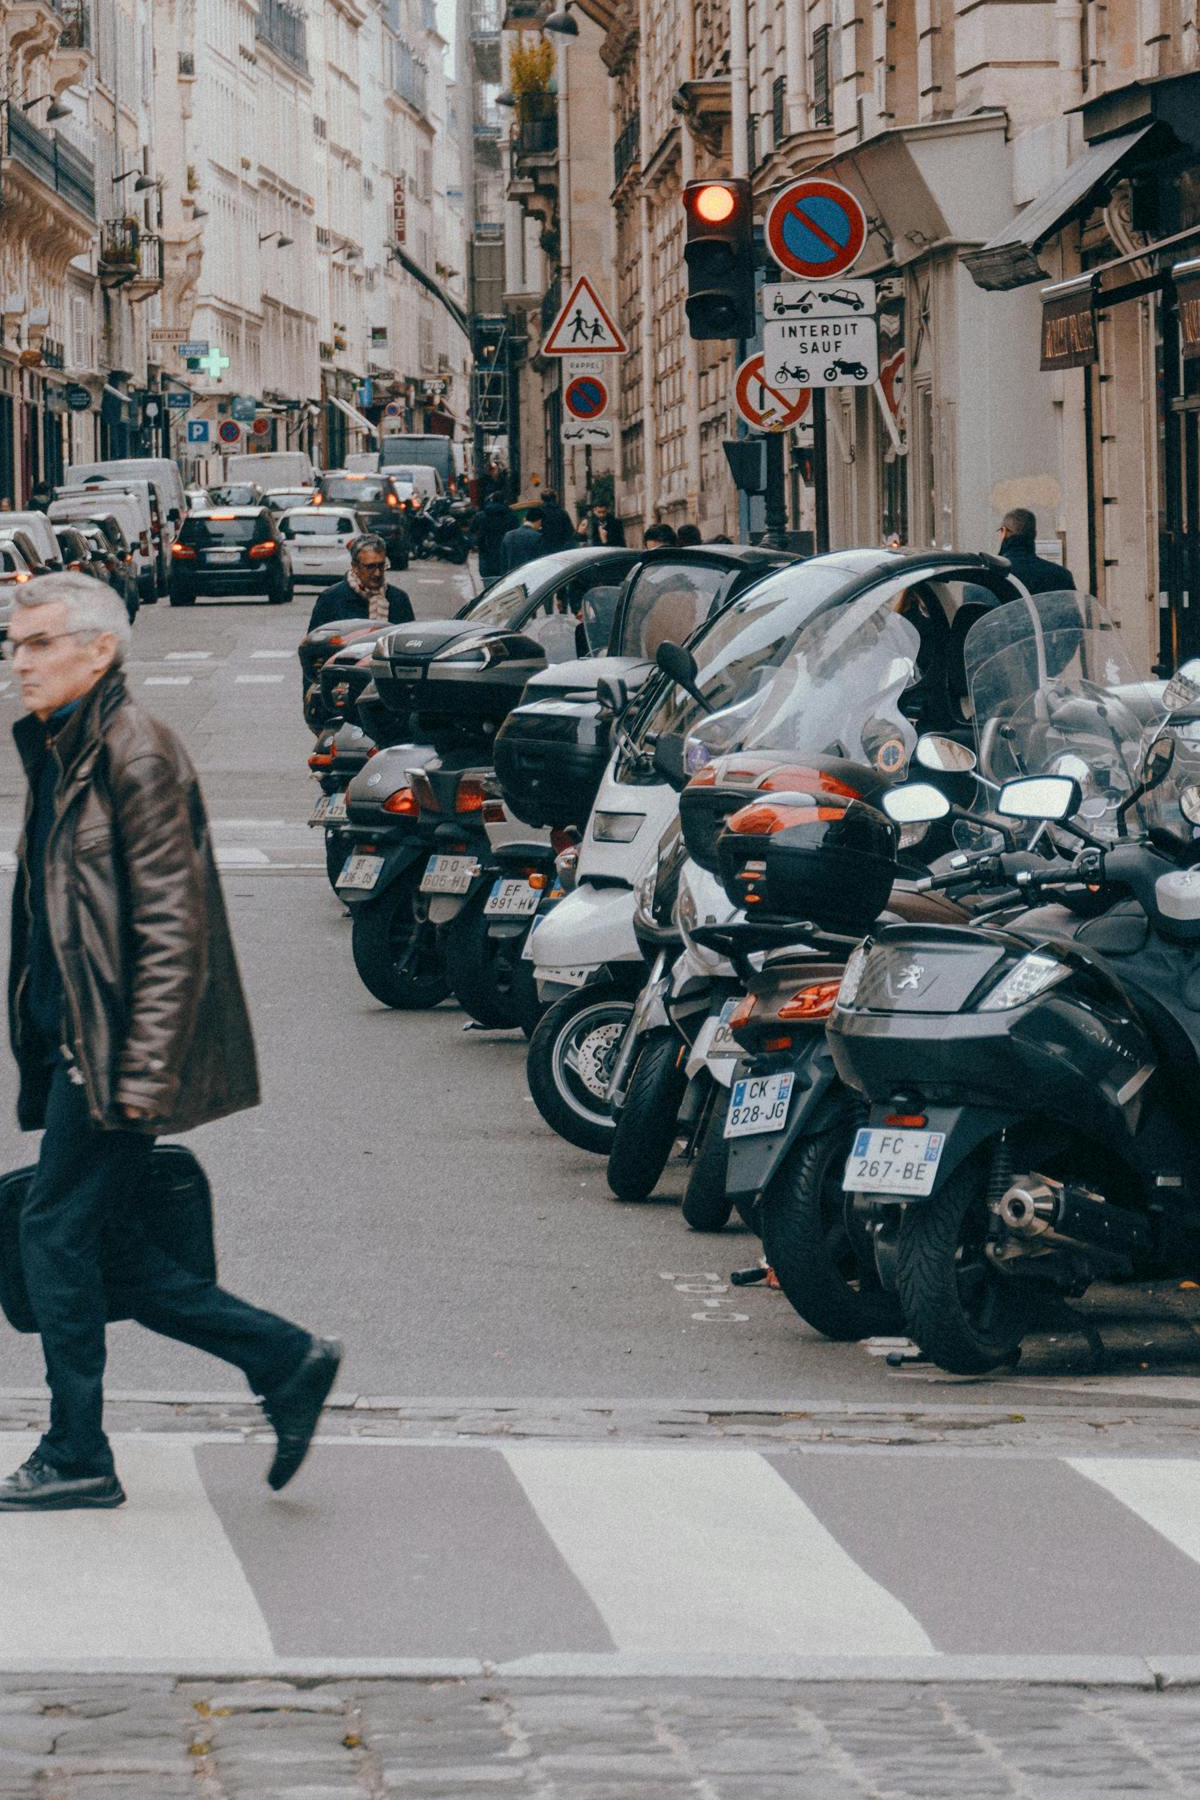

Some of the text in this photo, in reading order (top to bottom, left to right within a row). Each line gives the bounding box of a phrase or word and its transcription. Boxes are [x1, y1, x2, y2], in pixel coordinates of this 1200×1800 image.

[781, 323, 858, 338] INTERDIT
[799, 340, 842, 354] SAUF
[192, 423, 204, 440] P
[731, 1102, 785, 1126] 828-JG
[926, 1149, 937, 1159] 75
[857, 1161, 927, 1180] 267-BE
